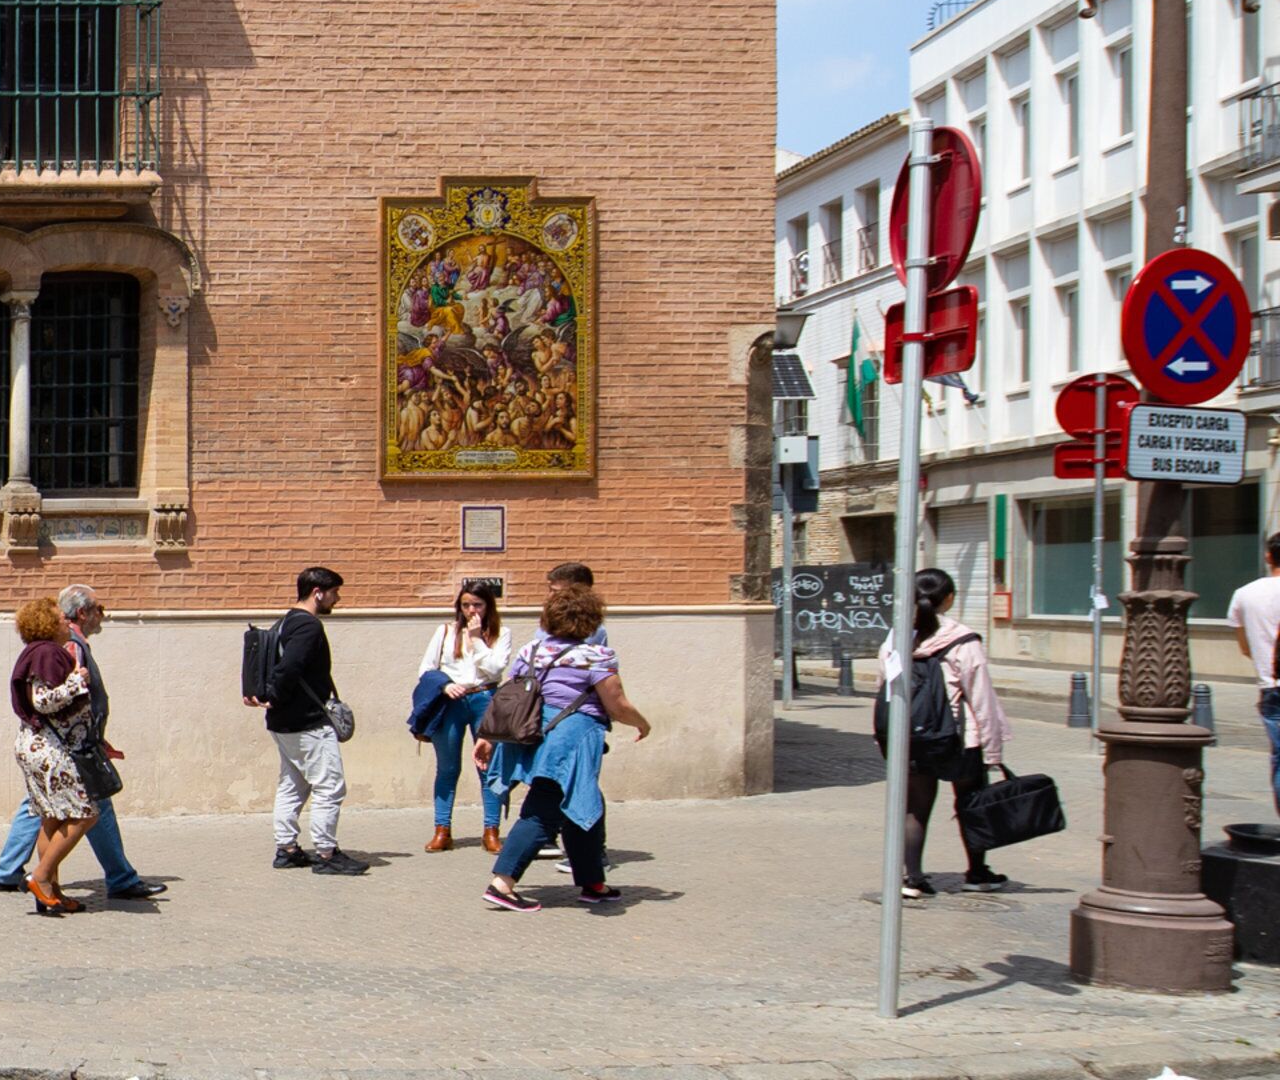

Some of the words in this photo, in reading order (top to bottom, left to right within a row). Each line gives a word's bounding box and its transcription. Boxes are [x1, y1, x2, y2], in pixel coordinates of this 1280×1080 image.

[1148, 413, 1193, 429] EXCEPTO
[1195, 416, 1229, 431] CARGA
[1137, 434, 1172, 449] CARGA
[1175, 436, 1182, 450] Y
[1183, 437, 1238, 453] DESCARGA
[1151, 457, 1173, 472] BUS
[1175, 458, 1222, 474] ESCOLAR
